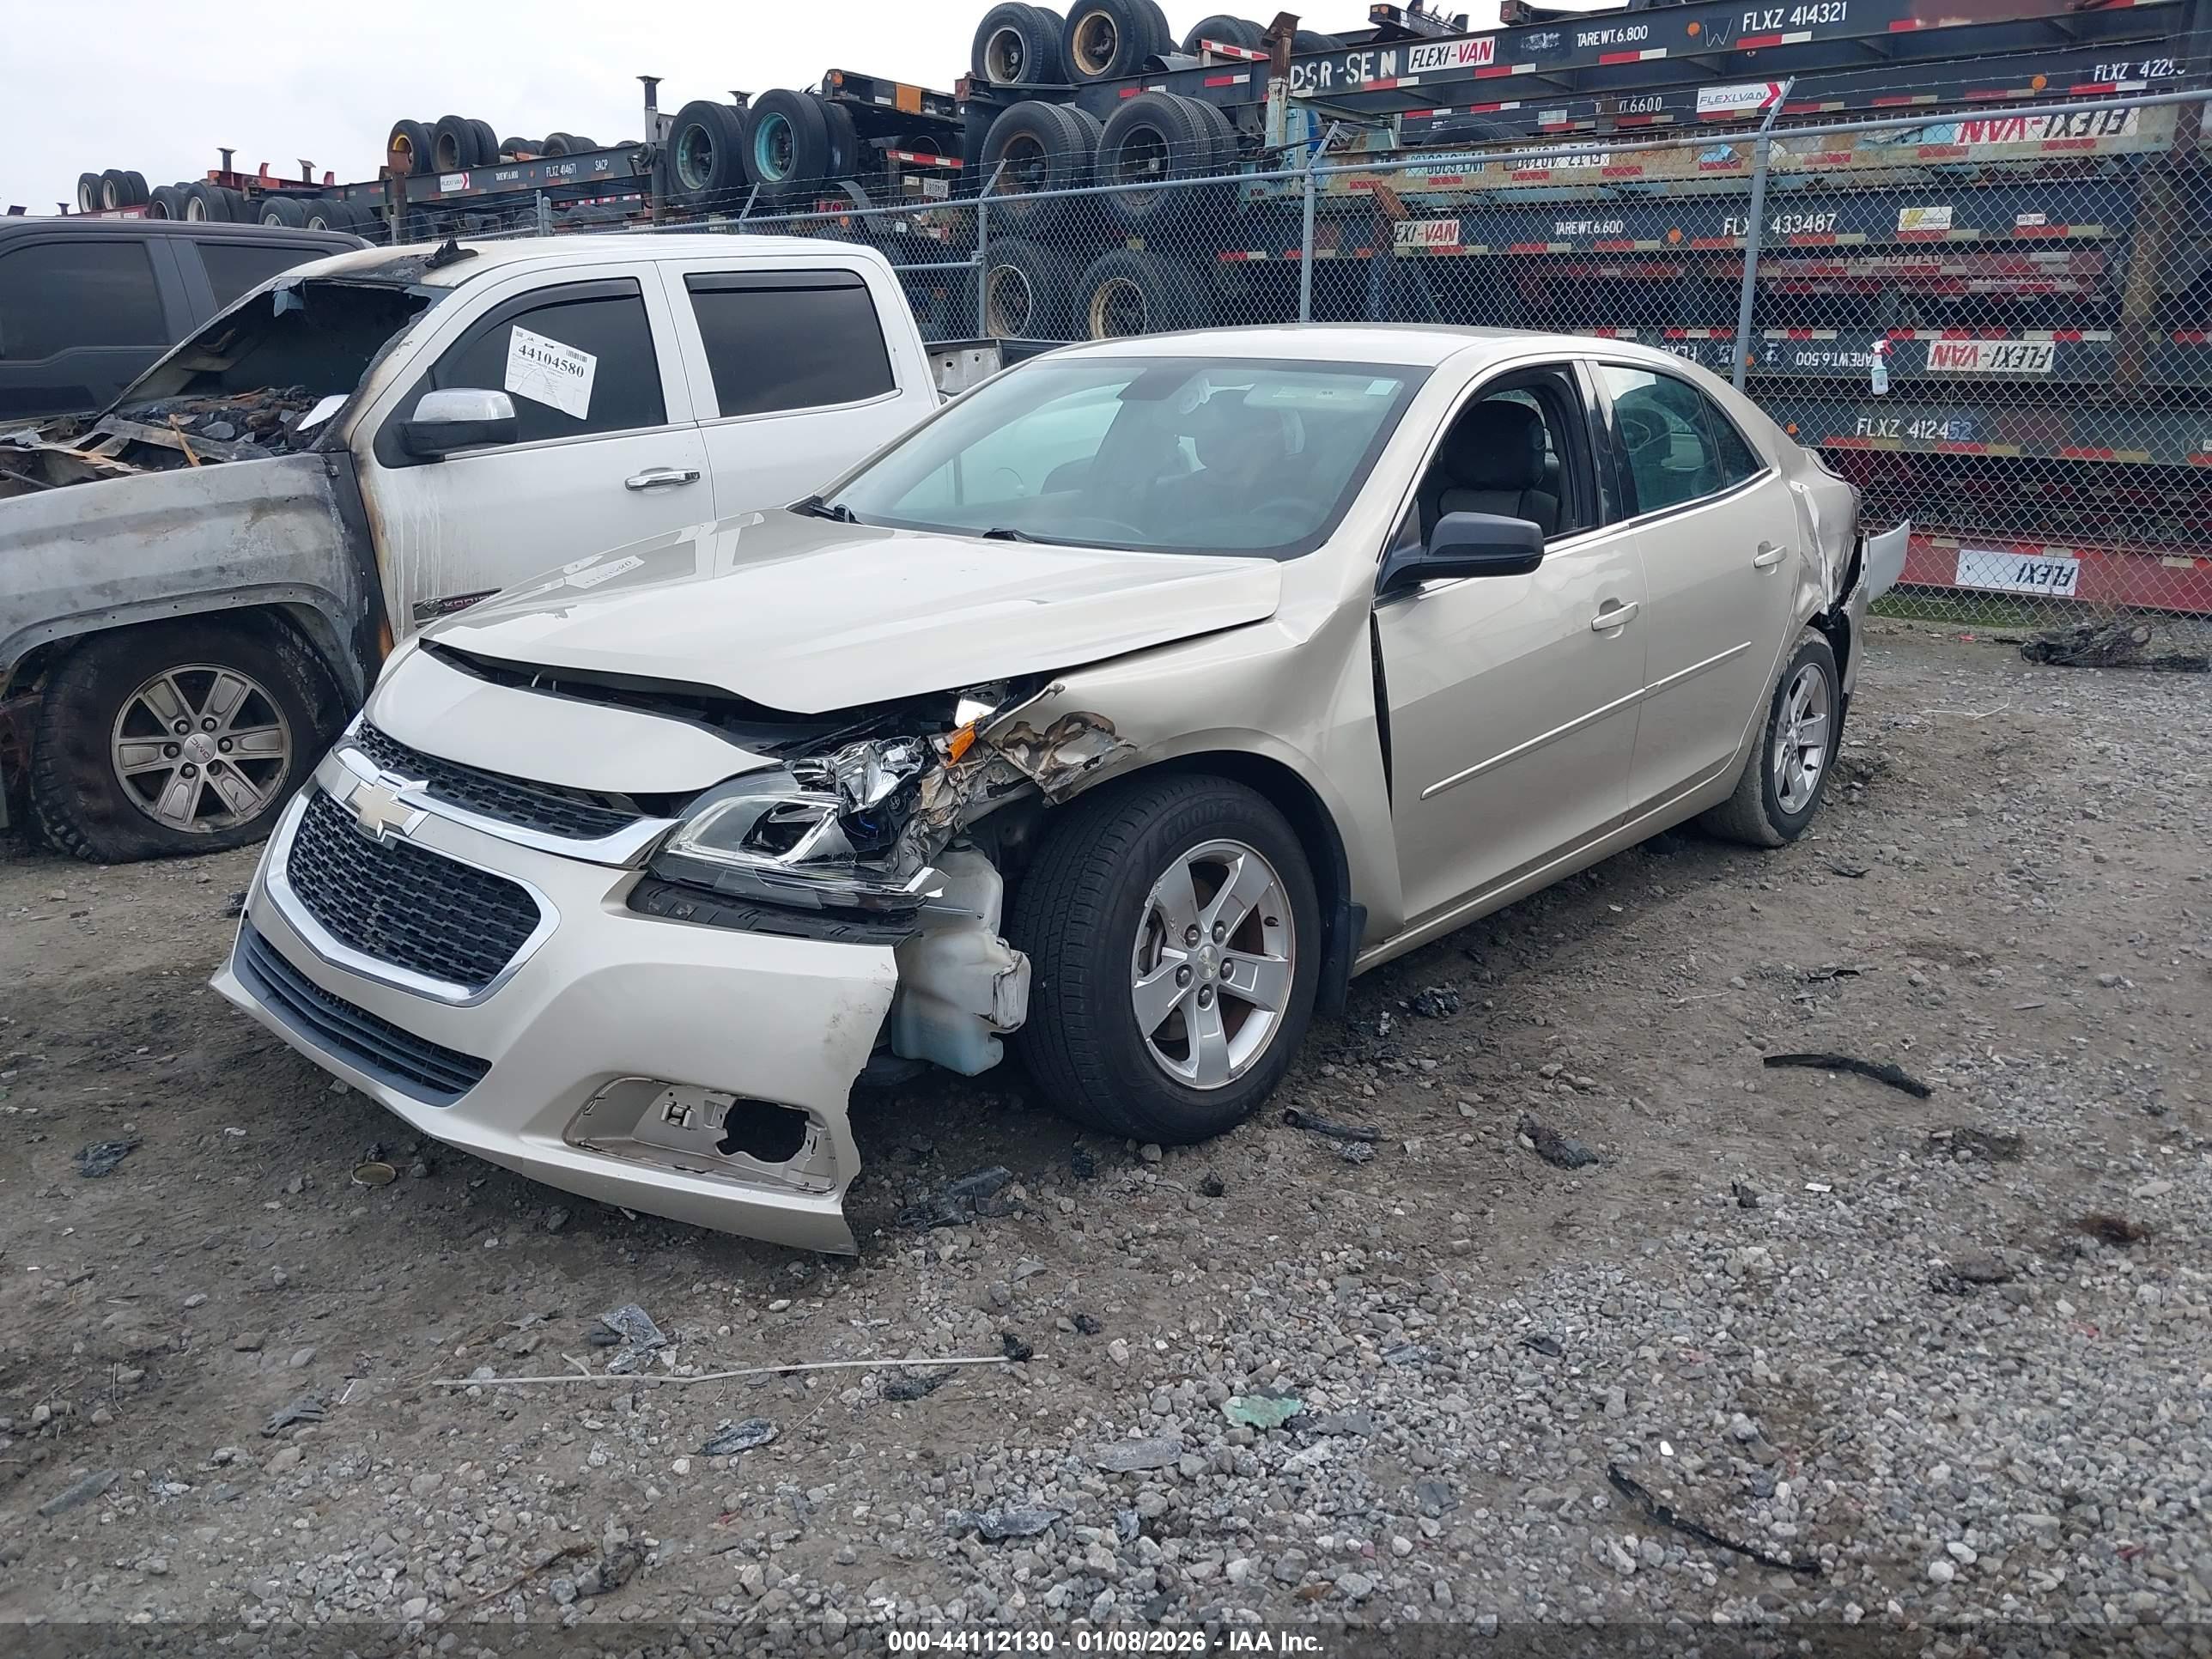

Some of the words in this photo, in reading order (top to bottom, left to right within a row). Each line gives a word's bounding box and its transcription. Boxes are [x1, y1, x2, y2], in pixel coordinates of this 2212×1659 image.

[1742, 9, 1785, 33] FLXZ
[1790, 1, 1848, 27] 414321
[1410, 40, 1492, 69] FLEXI-VAN
[2094, 62, 2130, 82] FLXZ
[1394, 222, 1458, 244] EXI-VAN
[1723, 216, 1763, 236] FLX
[1771, 213, 1837, 234] 433487
[518, 343, 585, 379] 44104580
[1930, 344, 2053, 370] FLEXI-VAN
[1856, 418, 1900, 439] FLXZ
[1906, 419, 1972, 441] 412452
[2016, 562, 2077, 587] FLEXI
